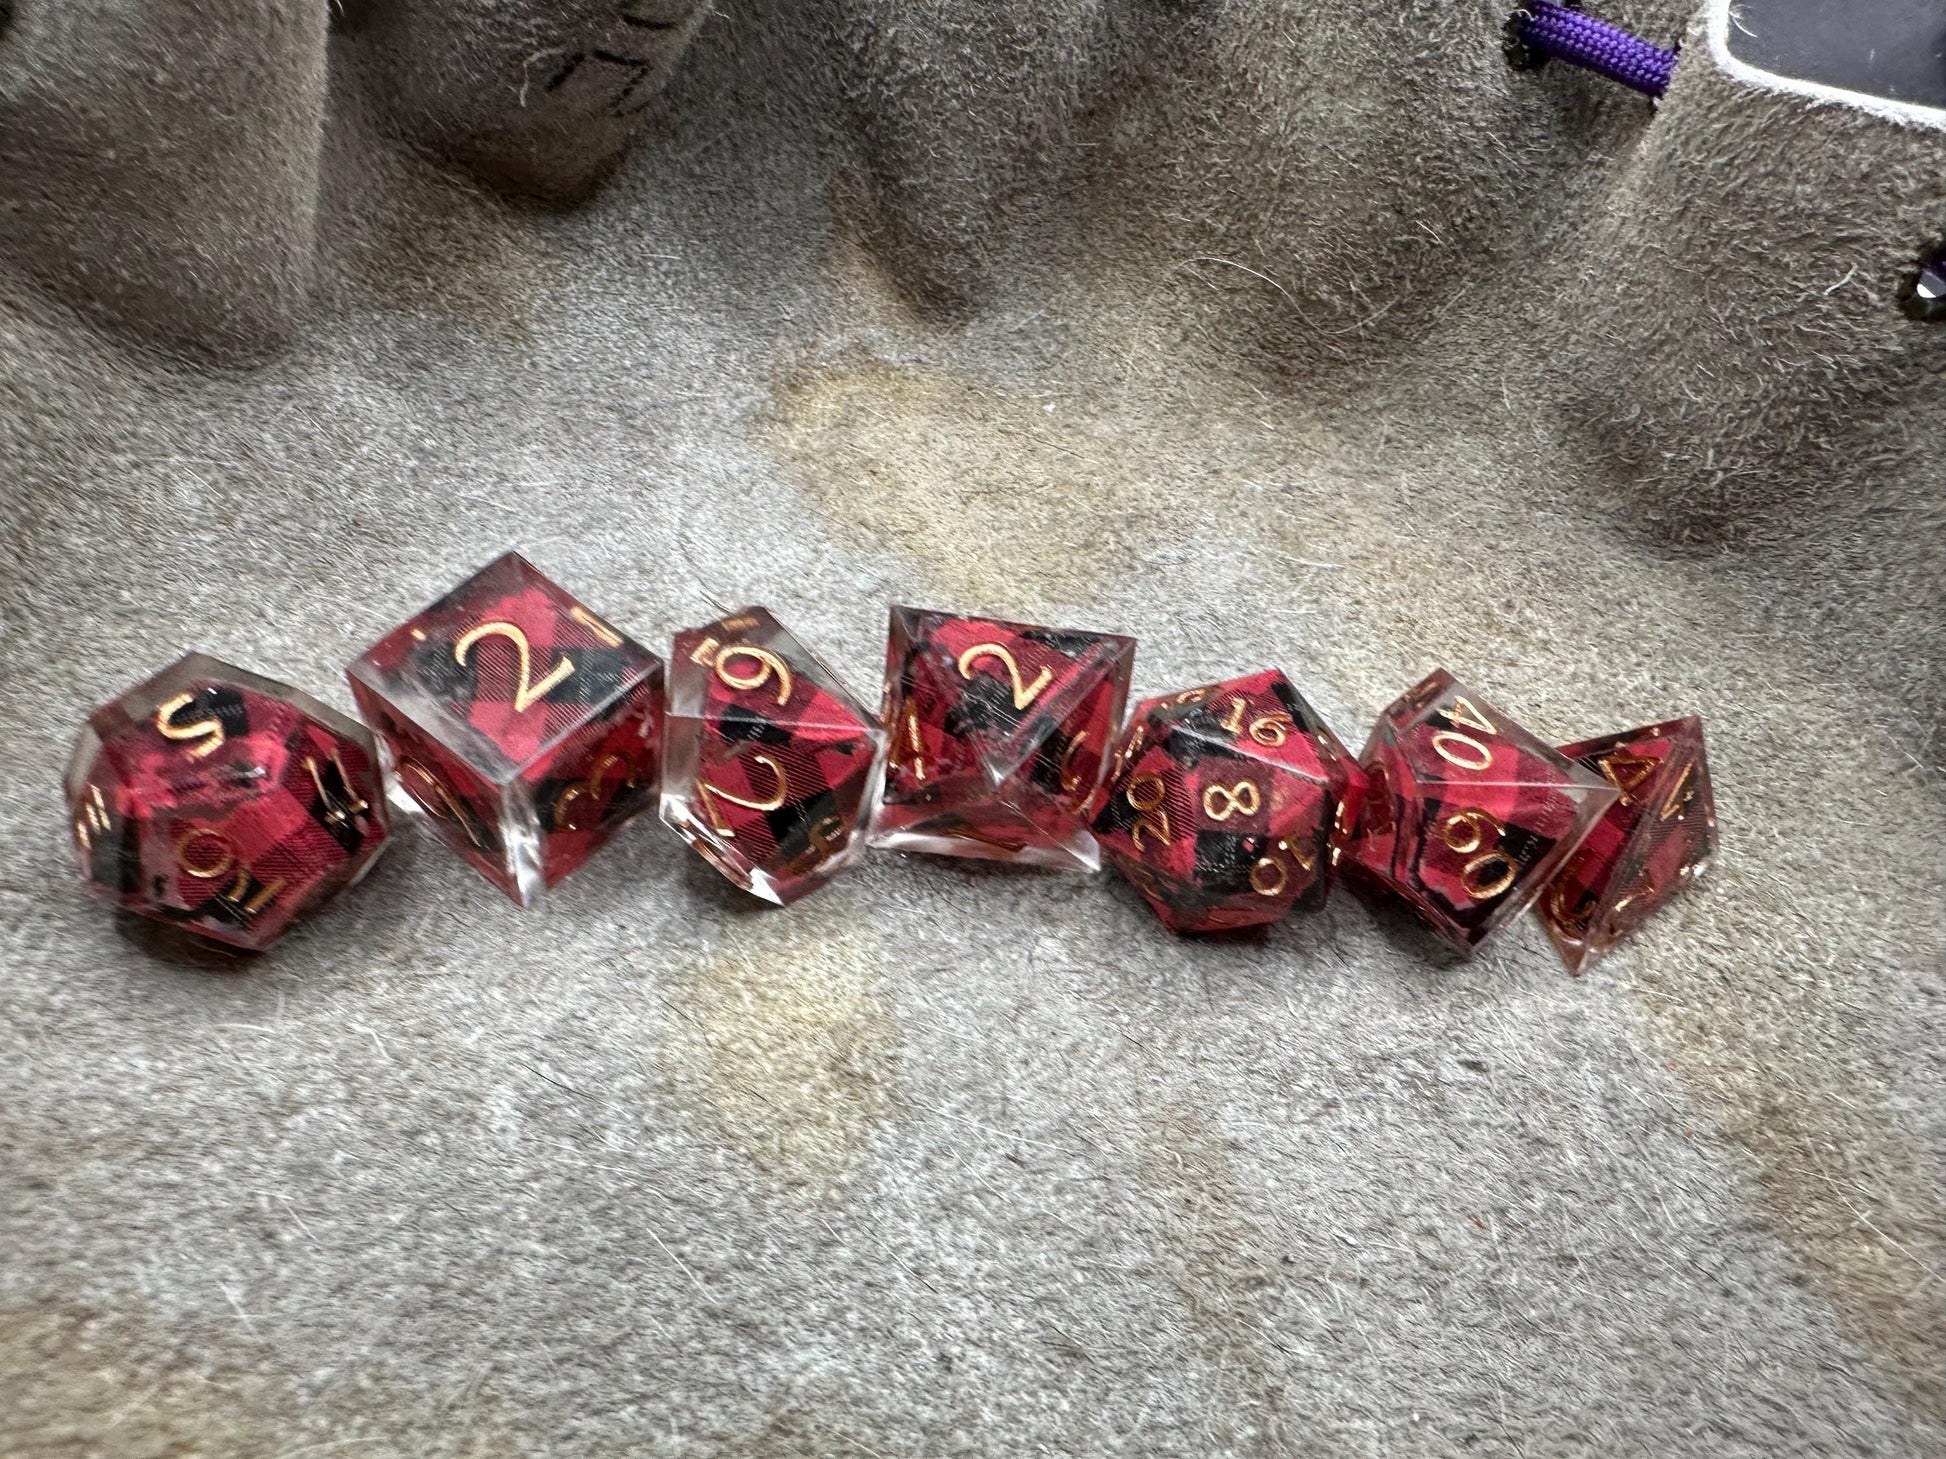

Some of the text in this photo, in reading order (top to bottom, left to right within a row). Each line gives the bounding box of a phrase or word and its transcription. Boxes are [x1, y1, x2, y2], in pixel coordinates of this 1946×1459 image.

[455, 619, 577, 714] 2
[958, 643, 1053, 711] 2
[1221, 697, 1294, 748] 16
[1431, 695, 1498, 771] 40
[694, 755, 789, 838] 2
[1125, 772, 1171, 853] 20
[1203, 781, 1261, 822] 8
[1249, 832, 1314, 897] 10
